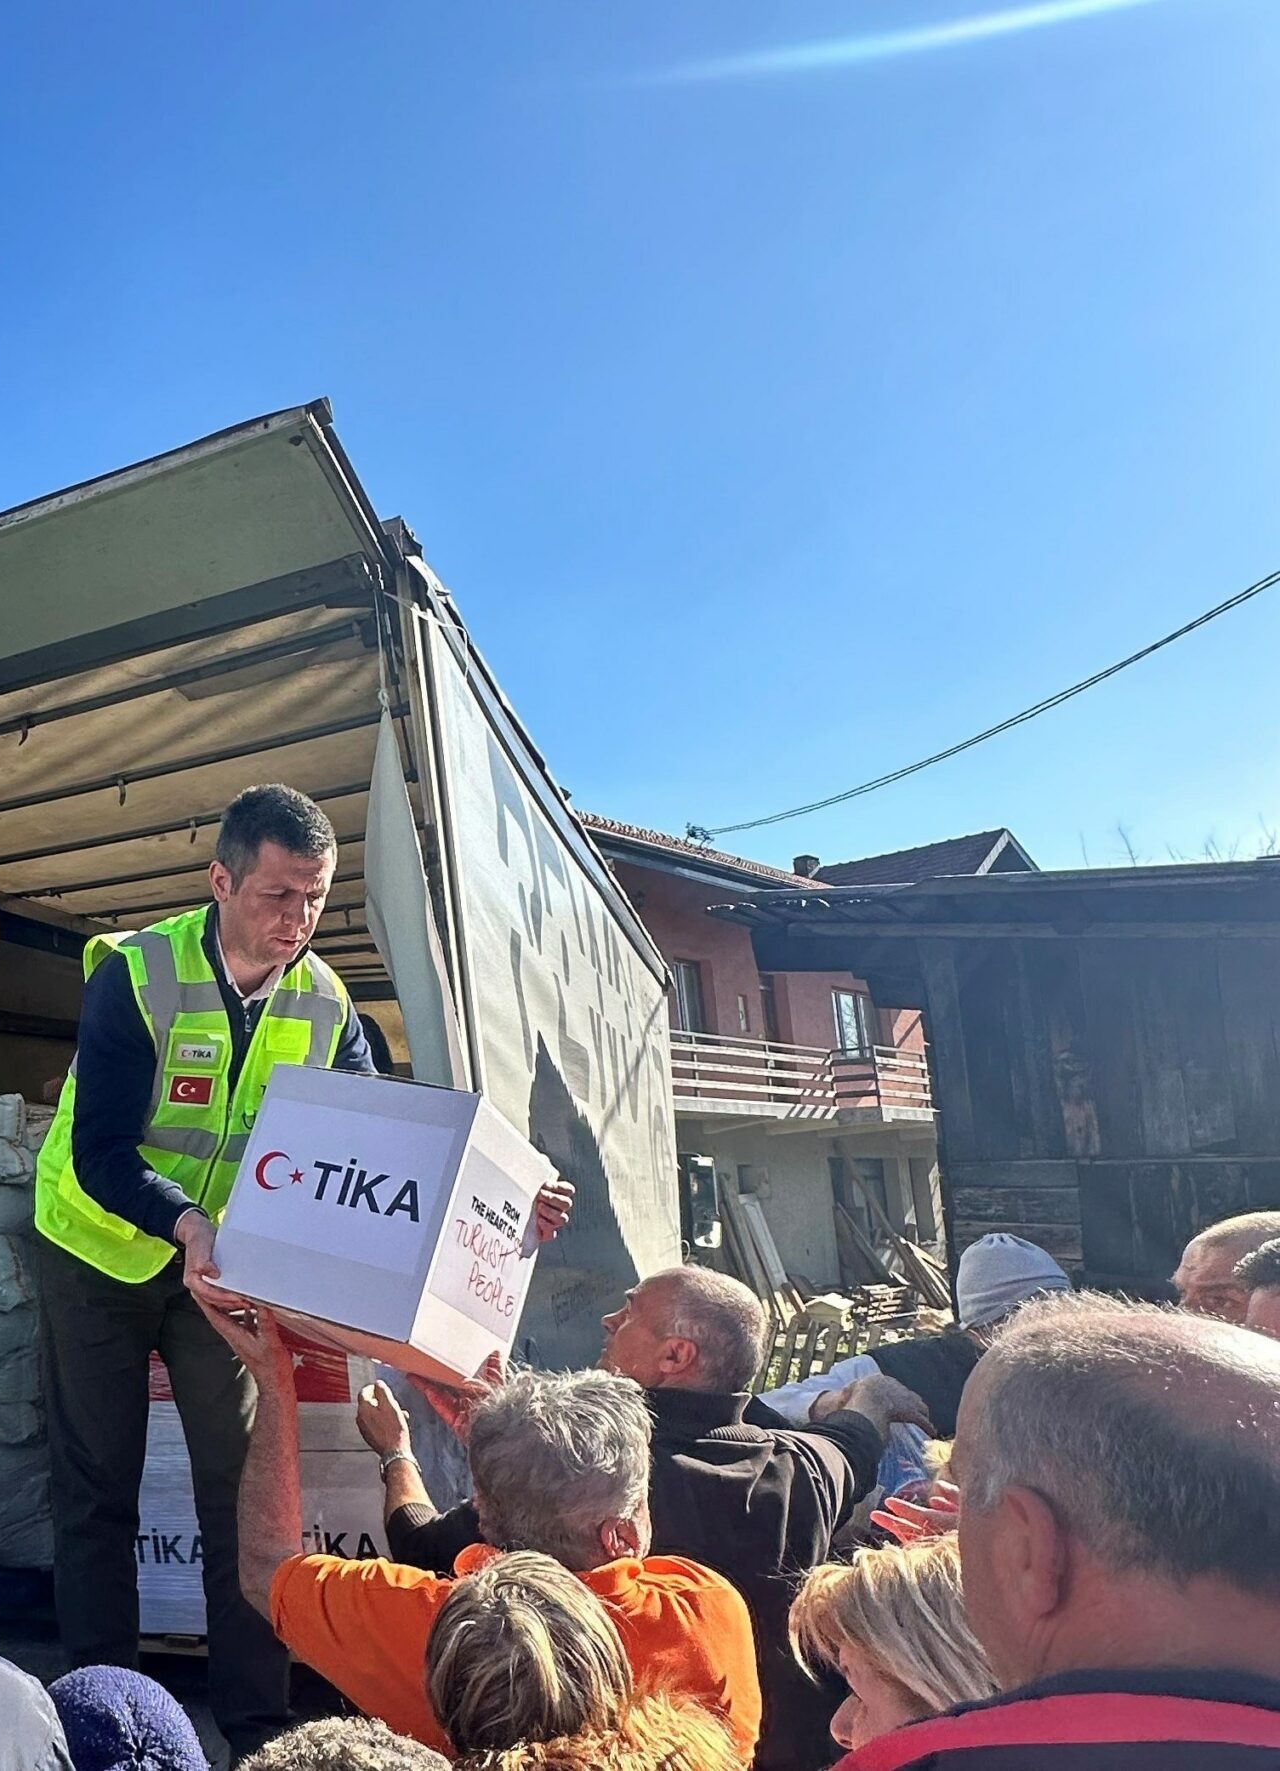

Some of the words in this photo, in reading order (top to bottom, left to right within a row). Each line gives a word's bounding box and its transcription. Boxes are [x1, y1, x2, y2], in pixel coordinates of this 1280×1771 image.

[313, 1158, 420, 1223] TİKA
[471, 1195, 487, 1218] THE
[484, 1207, 508, 1236] HEART
[506, 1225, 517, 1240] OF
[502, 1200, 521, 1225] FROM
[456, 1219, 511, 1273] TURKISH
[468, 1261, 515, 1317] PEOPLE
